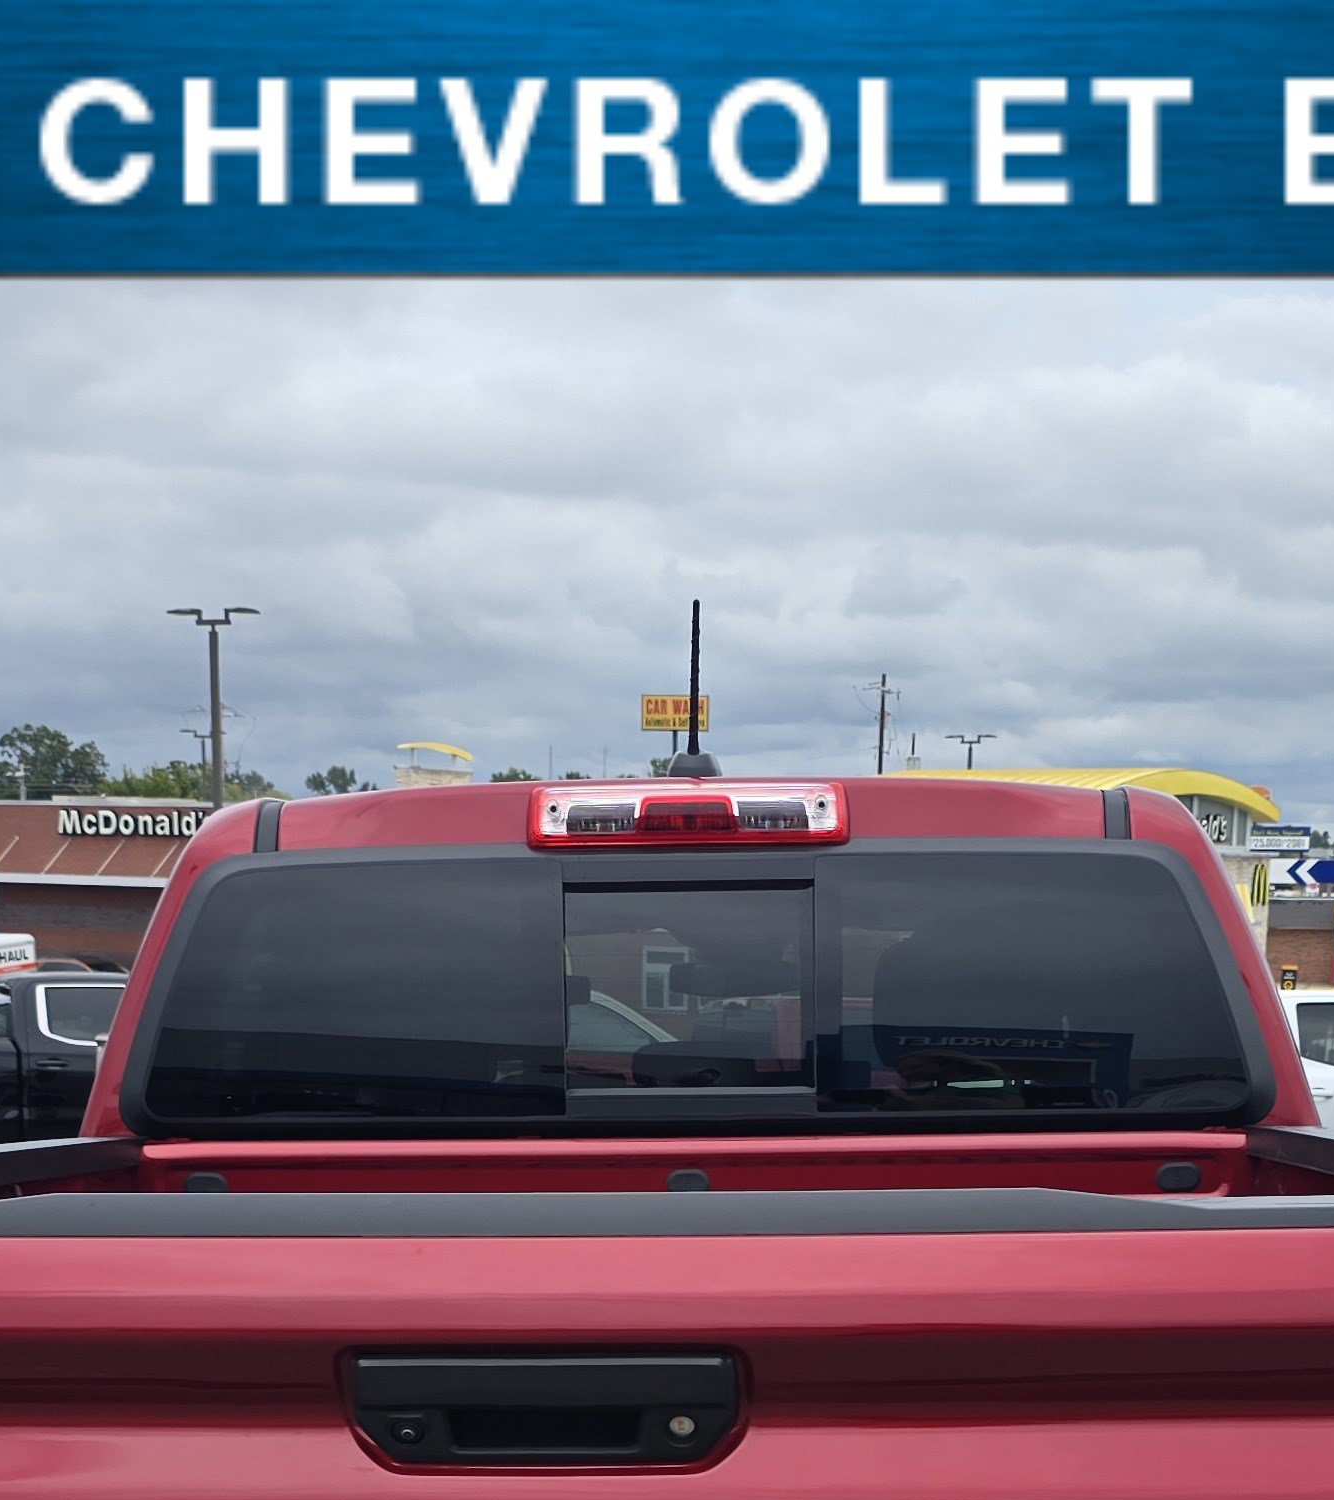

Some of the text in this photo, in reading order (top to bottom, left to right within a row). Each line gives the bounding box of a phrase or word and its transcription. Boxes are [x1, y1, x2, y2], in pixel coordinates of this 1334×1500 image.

[646, 699, 704, 715] CAR WAH
[57, 809, 208, 836] McDonald'
